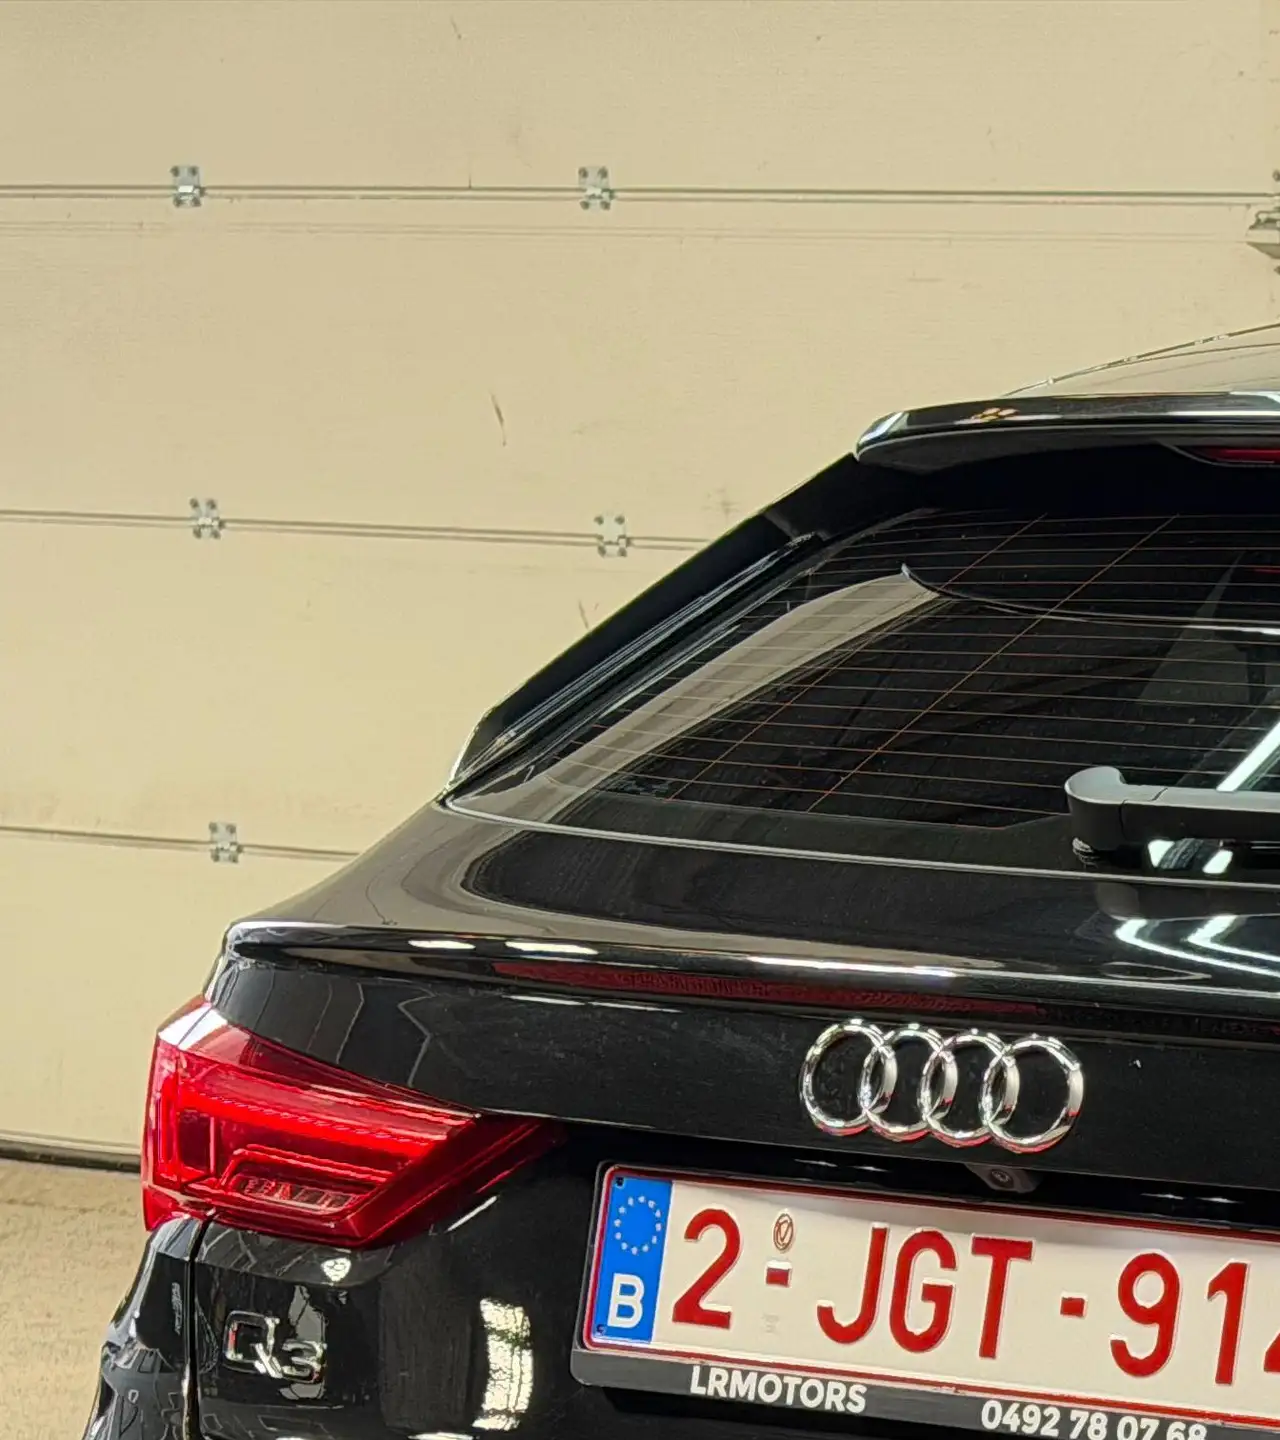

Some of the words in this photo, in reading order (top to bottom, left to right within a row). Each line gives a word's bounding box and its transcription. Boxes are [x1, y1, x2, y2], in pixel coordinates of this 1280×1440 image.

[607, 1272, 646, 1329] B
[690, 1364, 868, 1414] LRMOTORS
[981, 1399, 1061, 1438] 0492
